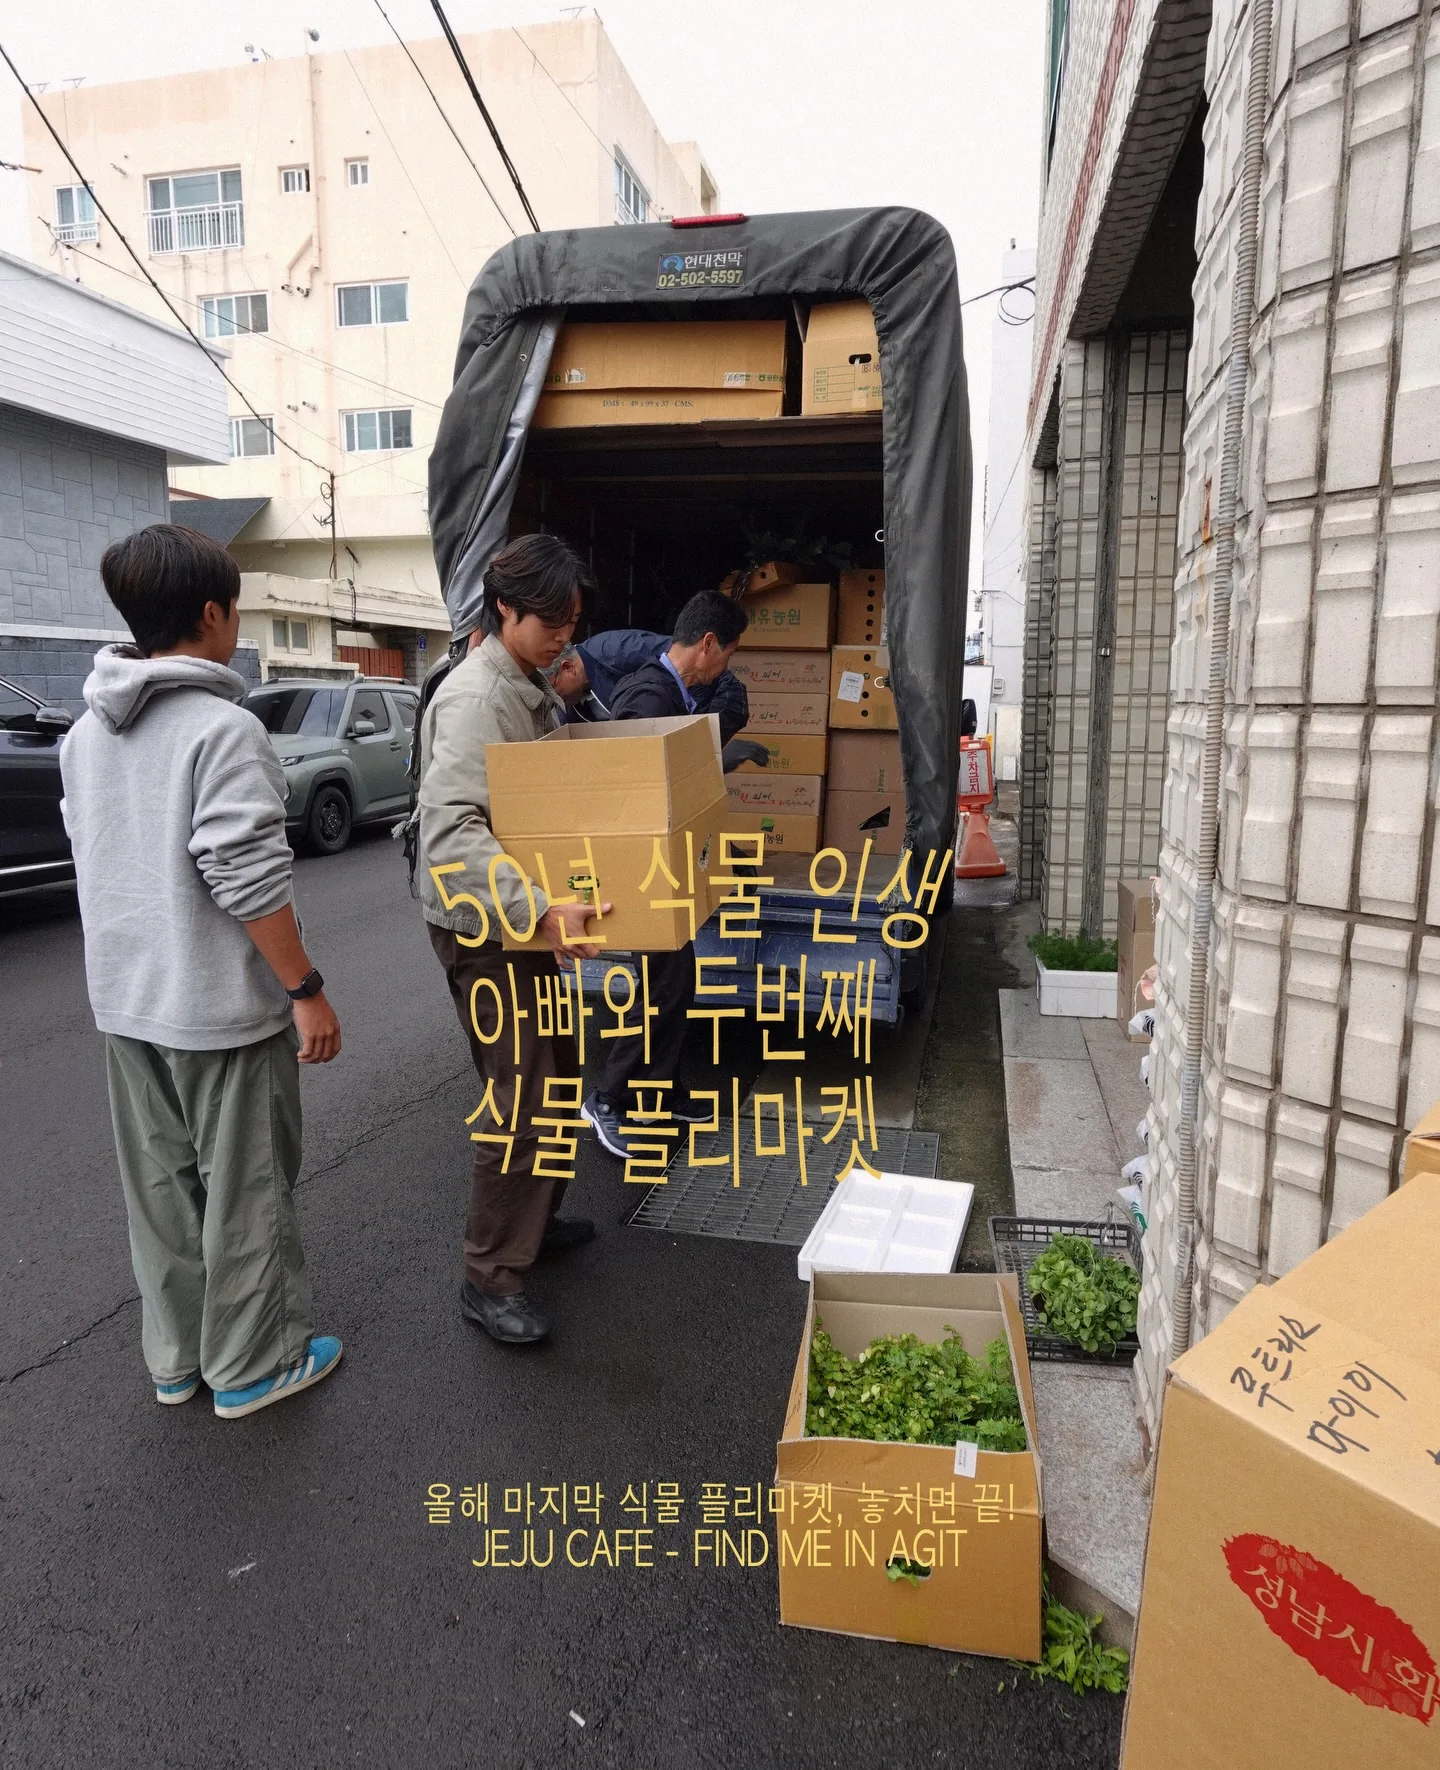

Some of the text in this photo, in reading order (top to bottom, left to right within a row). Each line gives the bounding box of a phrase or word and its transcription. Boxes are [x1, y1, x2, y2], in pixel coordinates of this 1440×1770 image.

[684, 252, 742, 269] 현대천막
[658, 270, 743, 287] 02-502-5597
[967, 750, 980, 794] 주차금지
[1244, 1564, 1375, 1674] 성남시
